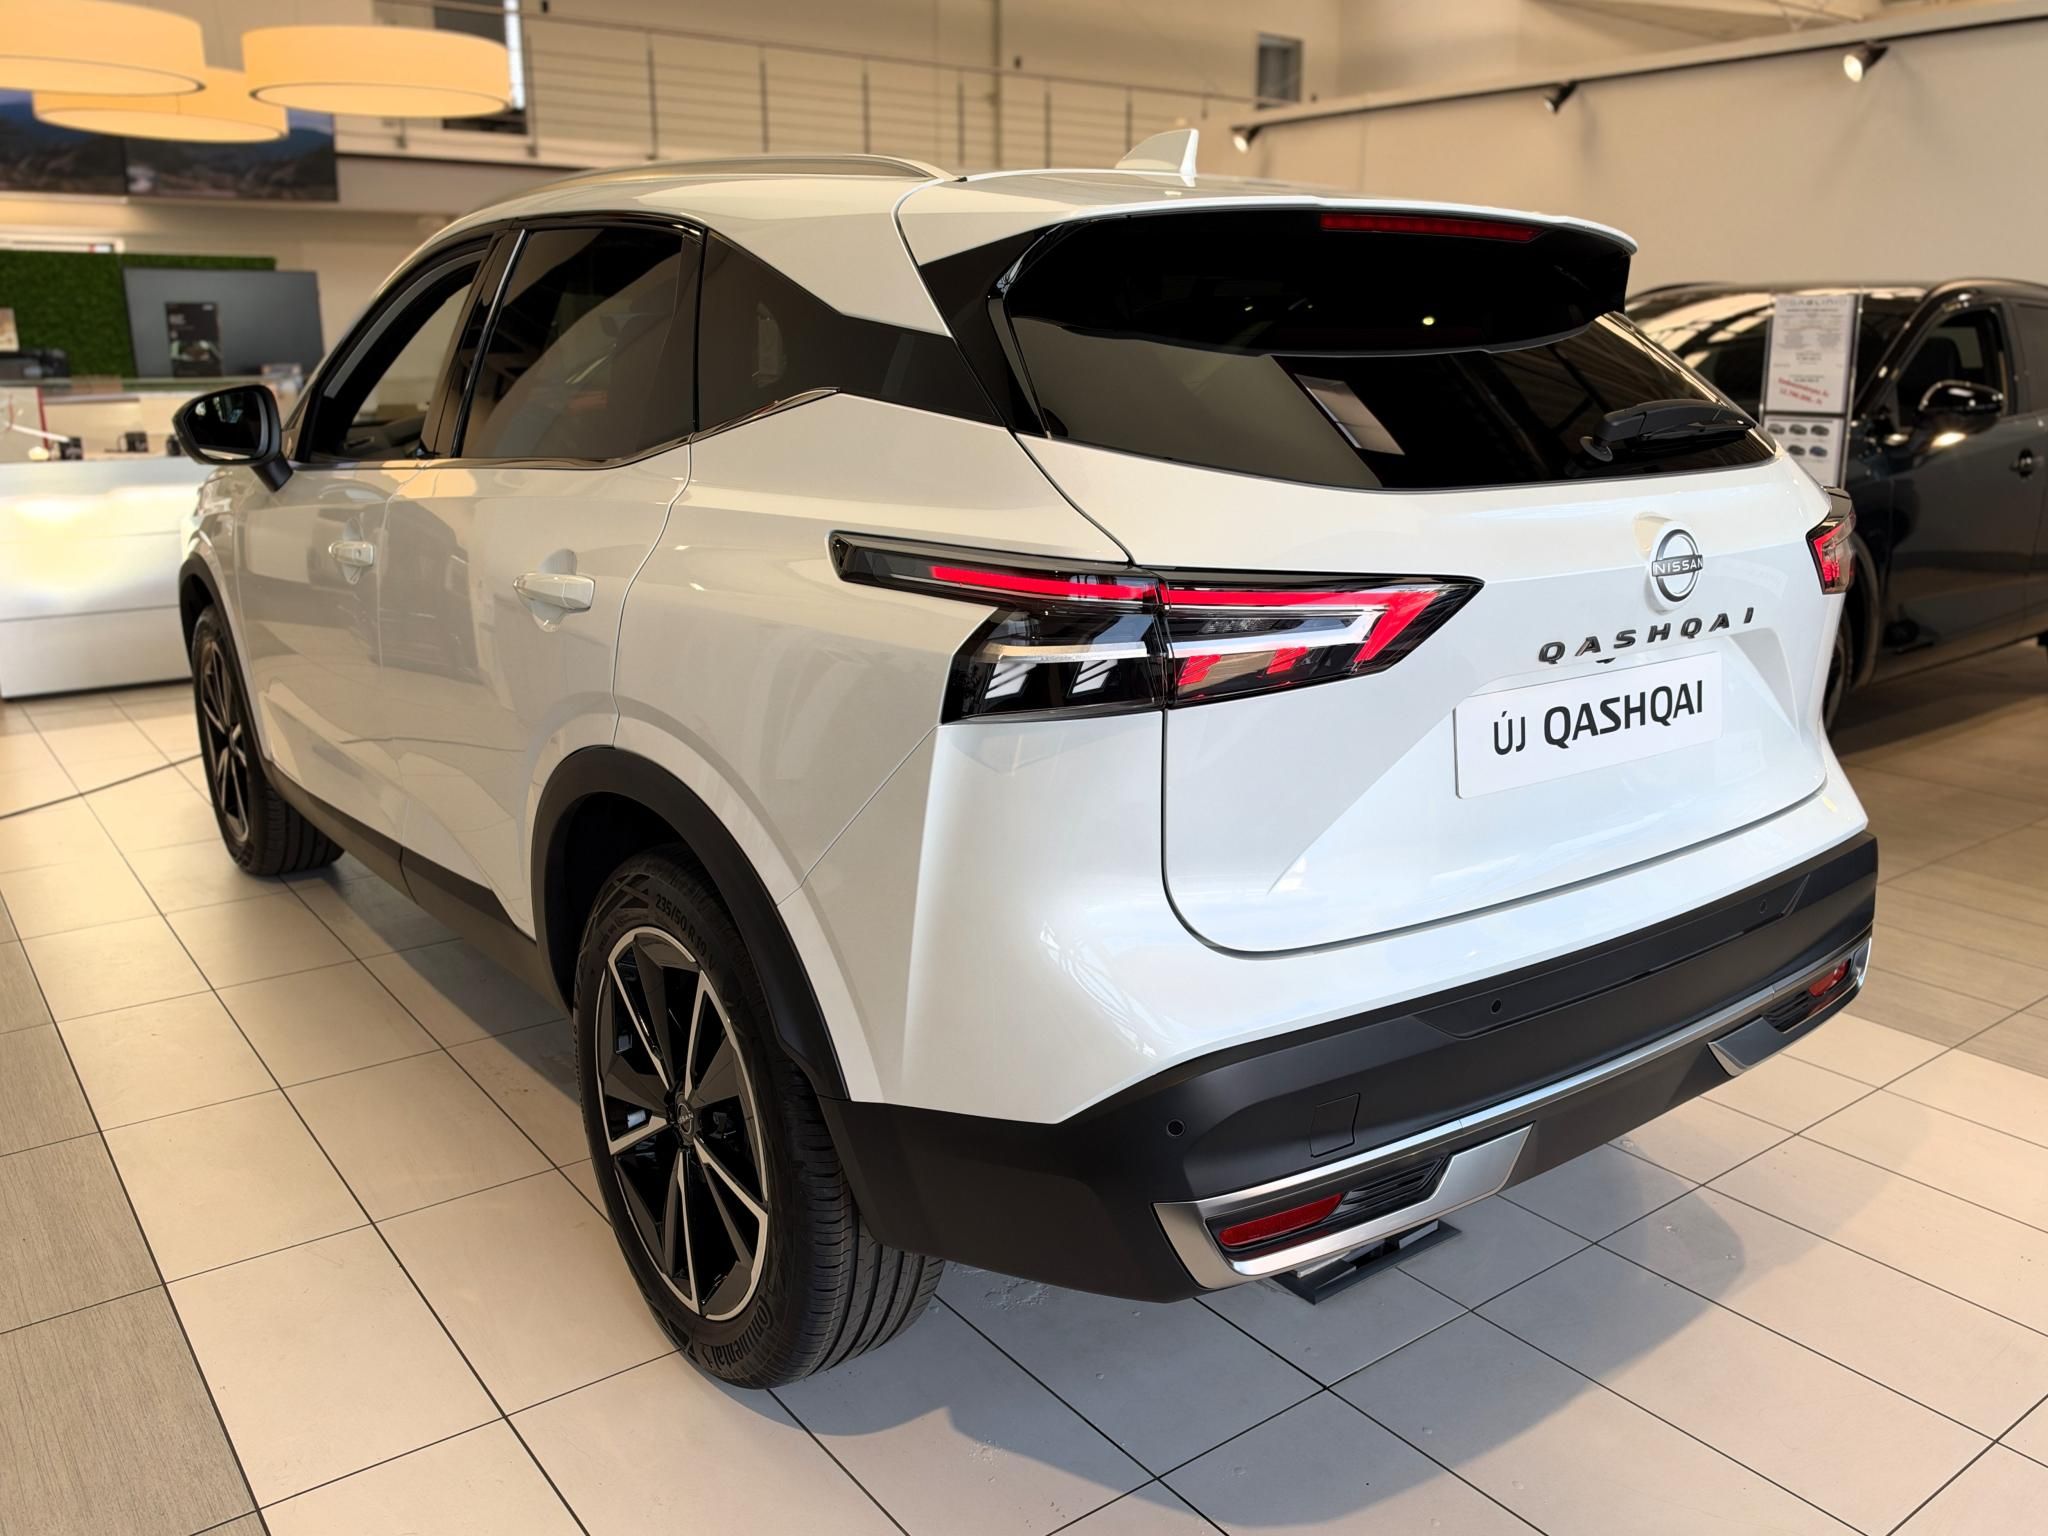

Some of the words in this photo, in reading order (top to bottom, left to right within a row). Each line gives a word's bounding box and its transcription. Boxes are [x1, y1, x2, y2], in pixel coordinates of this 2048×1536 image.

[1653, 555, 1703, 575] NISSAN
[1537, 606, 1755, 664] QASHQAI
[1493, 710, 1526, 756] ÚJ
[1543, 679, 1703, 749] QASHQAI
[655, 893, 688, 931] 235/50
[711, 1294, 774, 1371] Continental
